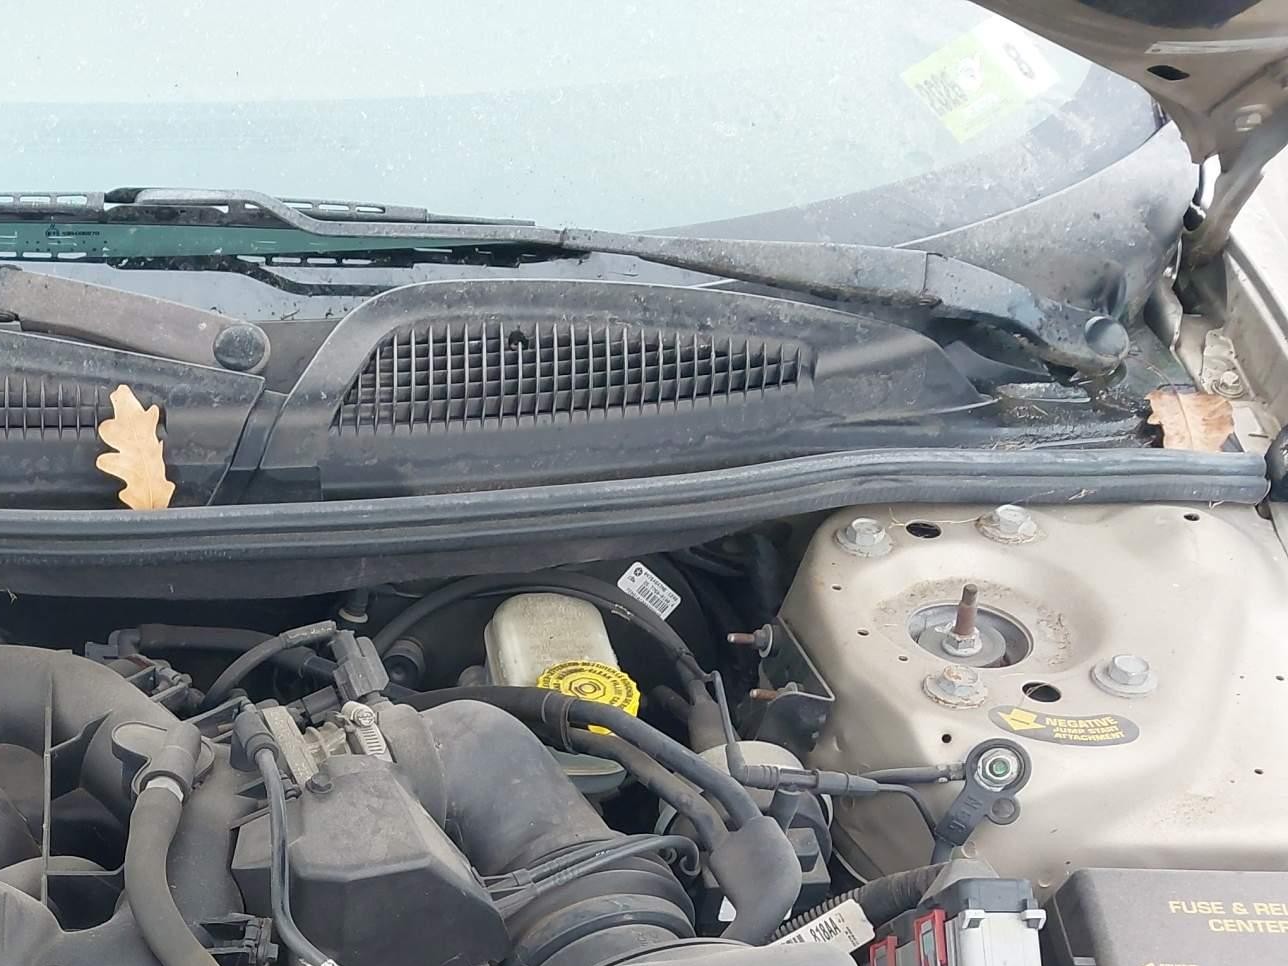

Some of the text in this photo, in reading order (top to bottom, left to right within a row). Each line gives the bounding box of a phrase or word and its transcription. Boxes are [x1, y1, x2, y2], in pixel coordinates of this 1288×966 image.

[1045, 716, 1119, 728] NEGATIVE
[1087, 725, 1120, 734] START
[1053, 731, 1126, 741] ATTACHMENT
[1168, 900, 1226, 914] FUSE
[1231, 902, 1249, 915] &
[1208, 919, 1288, 933] CENTER
